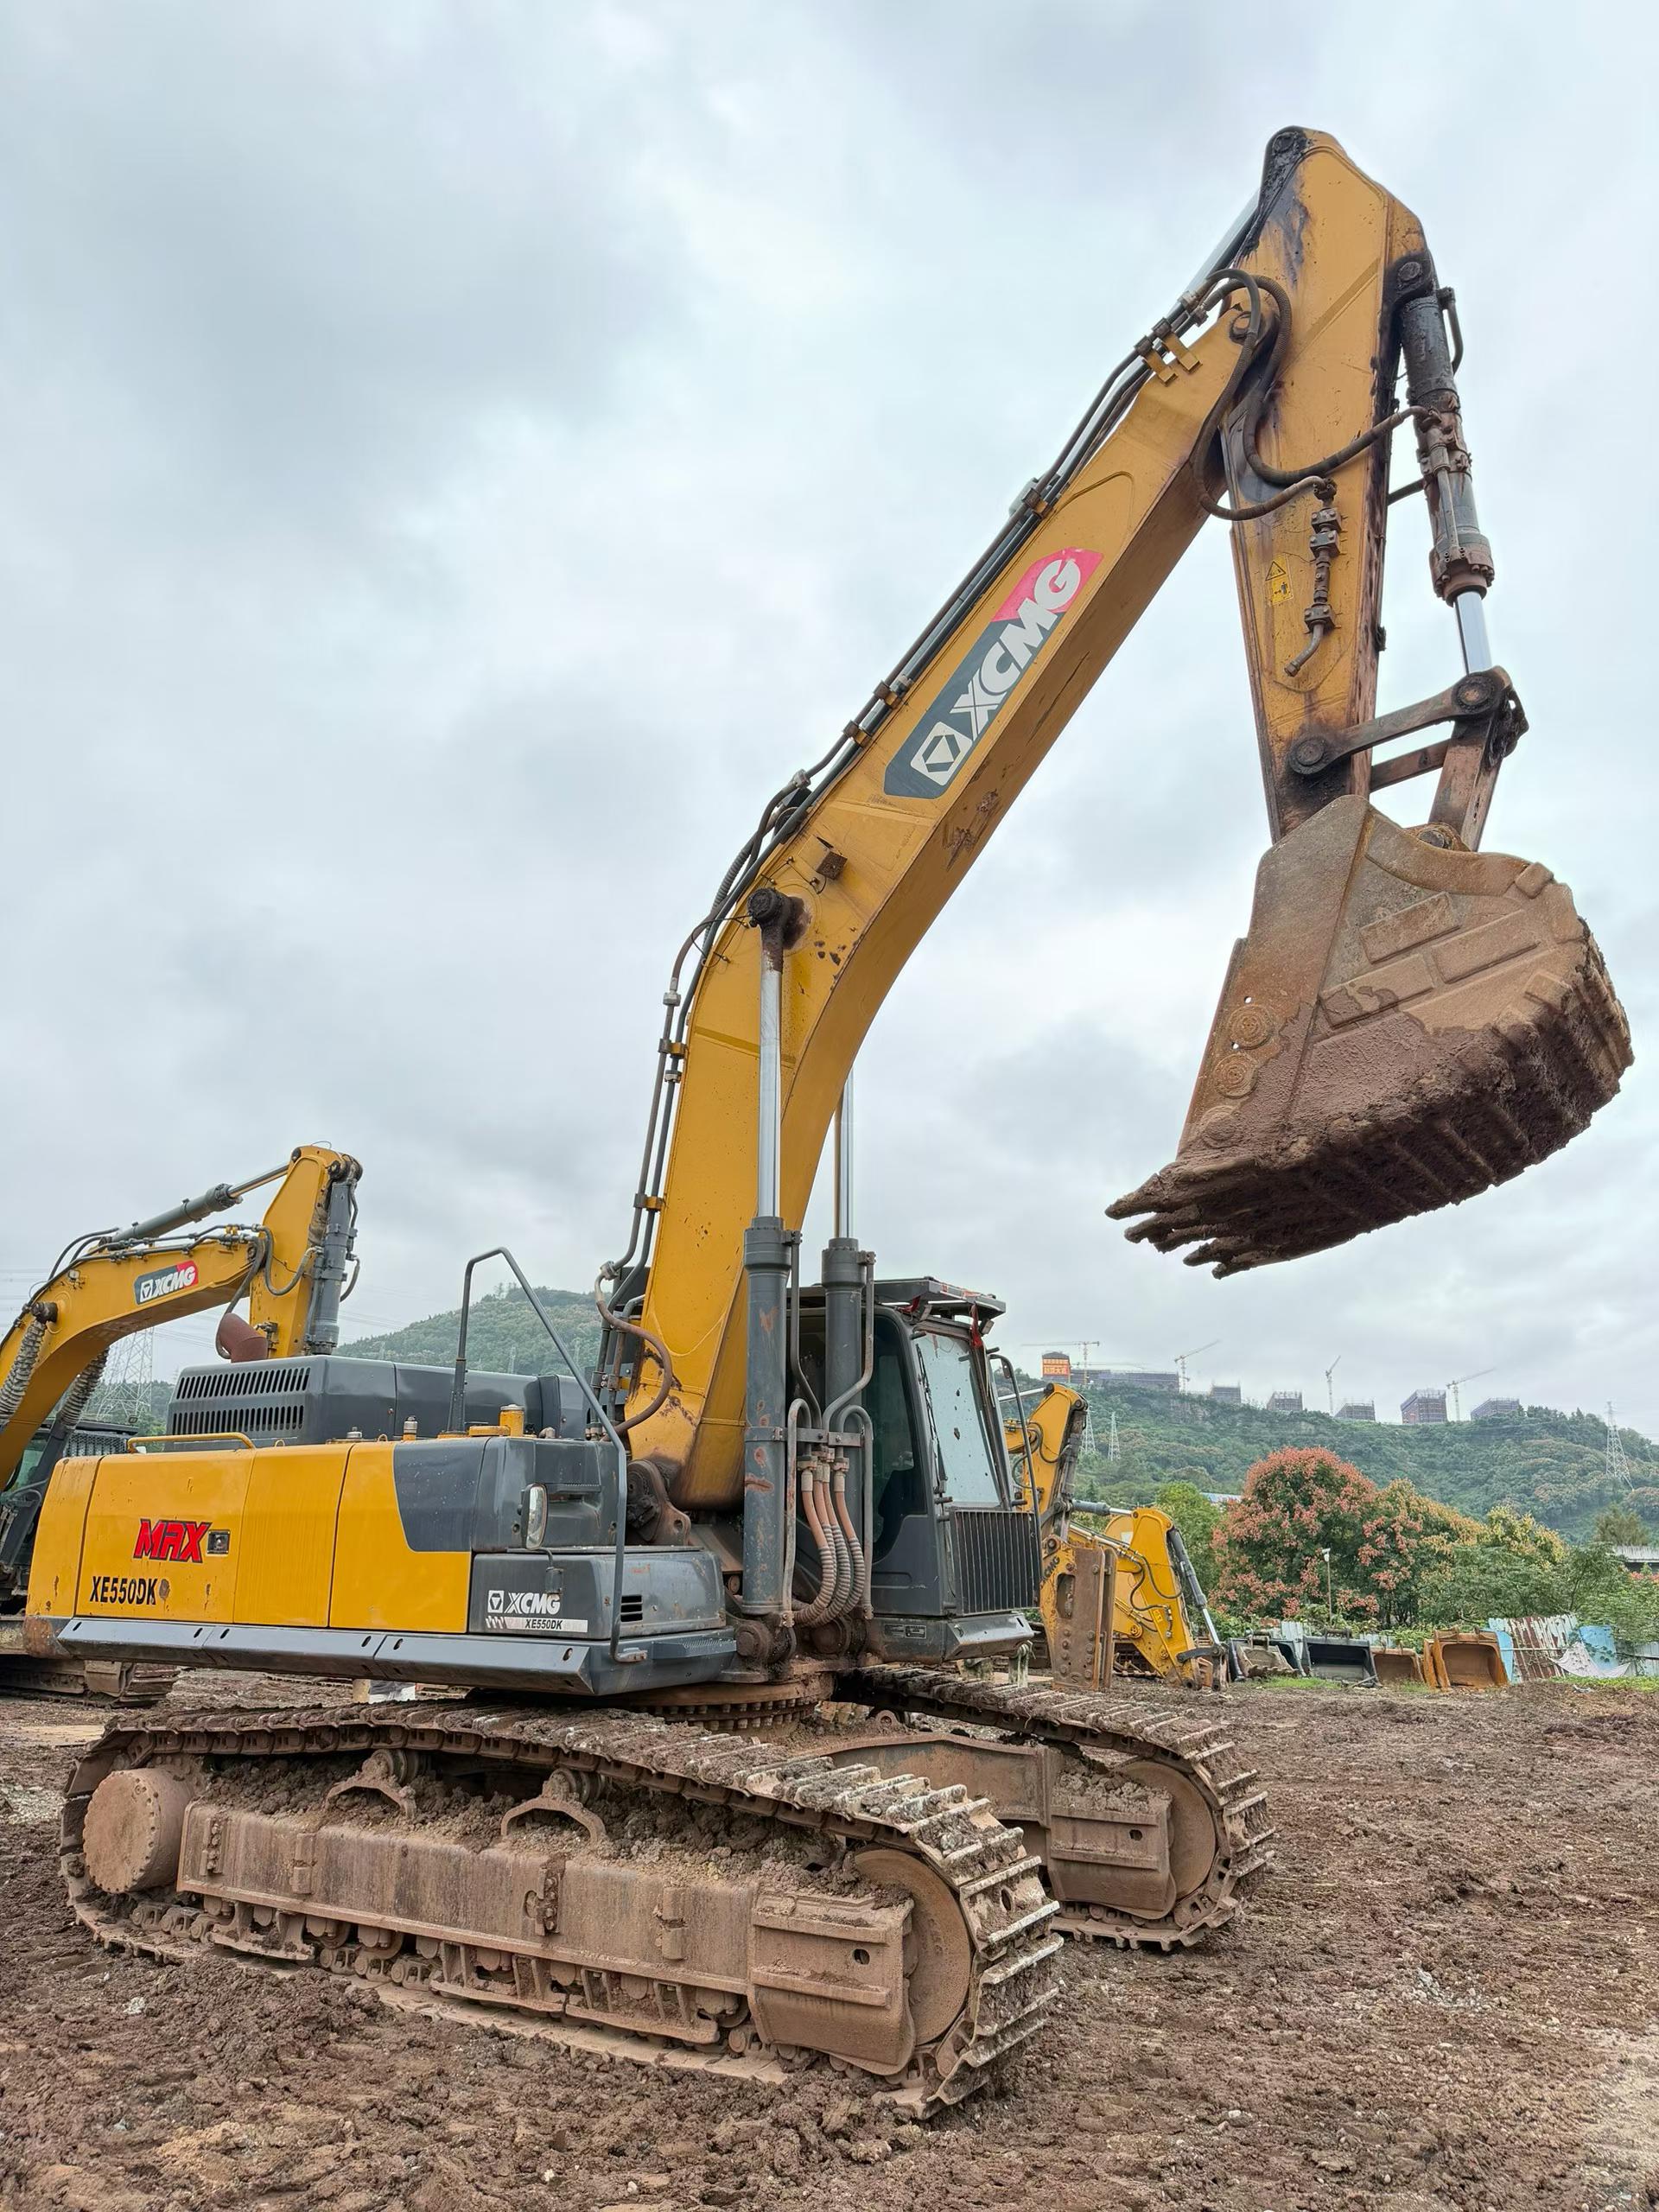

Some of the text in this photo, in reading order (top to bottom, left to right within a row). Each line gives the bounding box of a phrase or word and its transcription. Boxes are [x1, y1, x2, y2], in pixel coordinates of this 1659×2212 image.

[949, 559, 1081, 742] XCMG
[151, 1265, 196, 1297] XCMG
[133, 1519, 213, 1563] MAX
[90, 1575, 158, 1605] XE550DK
[504, 1592, 561, 1615] XCMG
[524, 1618, 563, 1630] XE550DK
